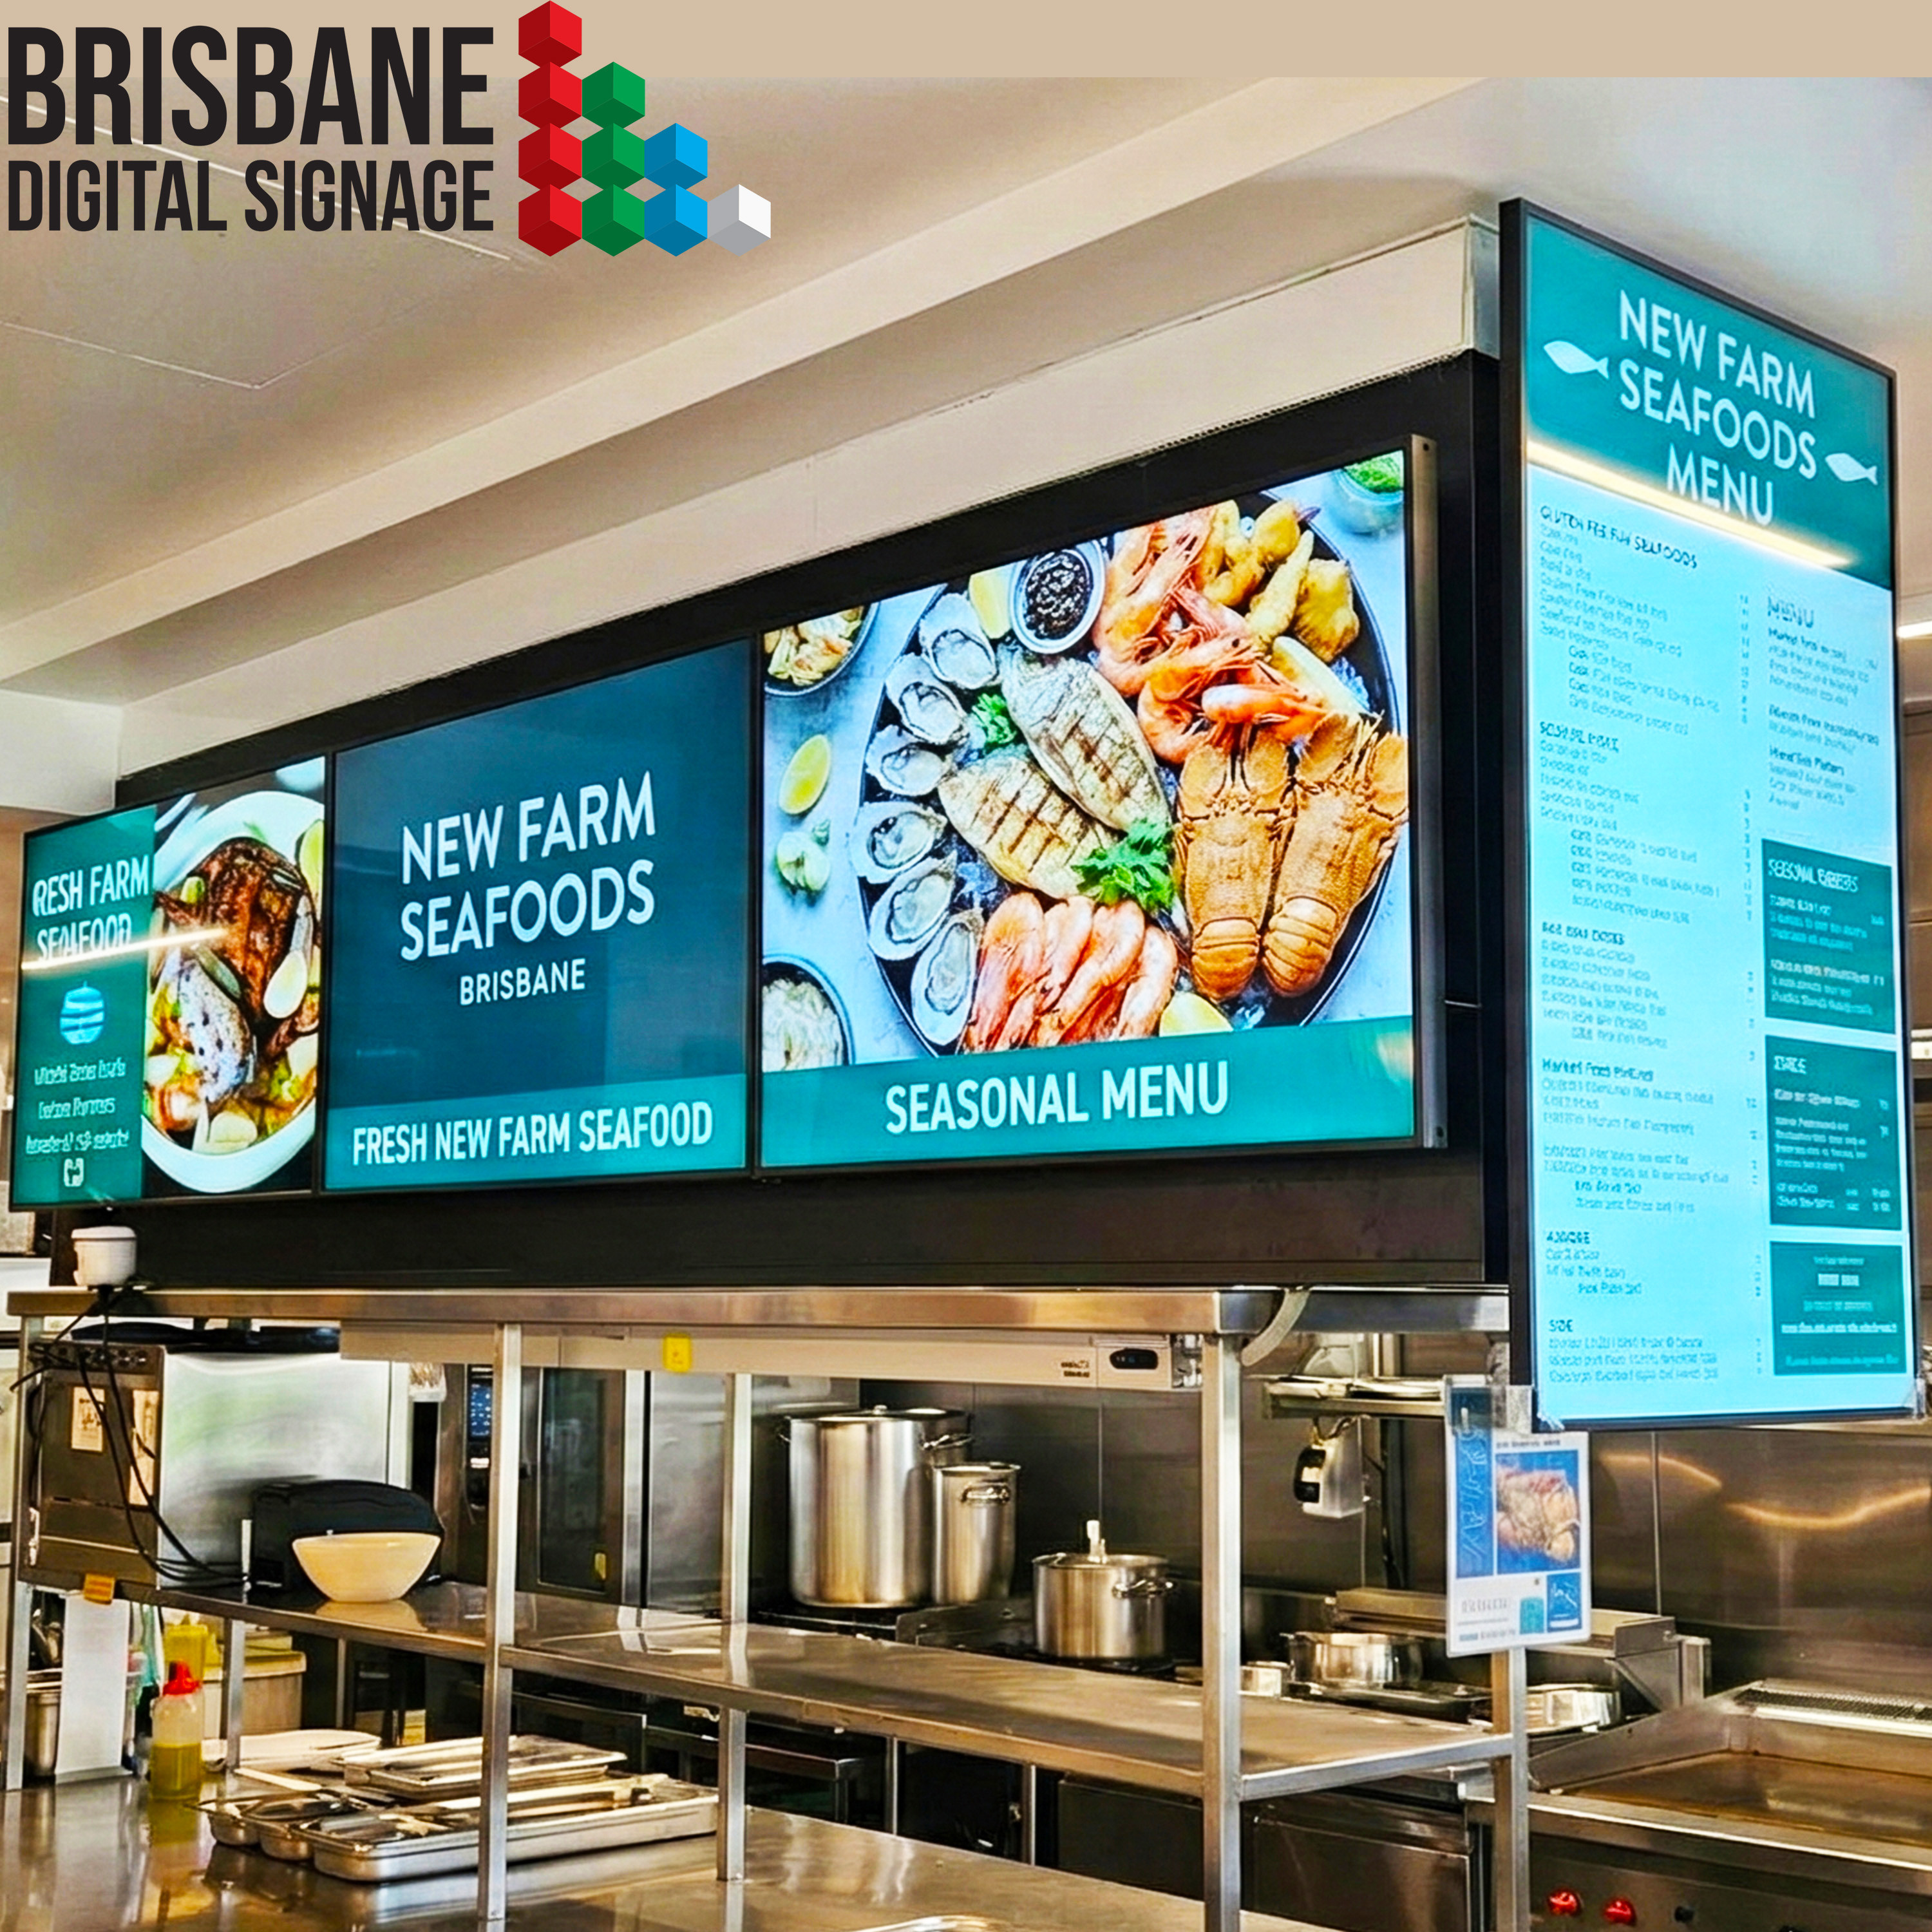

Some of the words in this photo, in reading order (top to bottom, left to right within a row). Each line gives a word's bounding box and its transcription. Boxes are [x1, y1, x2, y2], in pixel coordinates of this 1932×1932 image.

[1619, 289, 1707, 372] NEW
[1717, 332, 1815, 419] FARM
[1619, 358, 1817, 479] SEAFOODS
[1667, 442, 1773, 526] MENU
[402, 805, 504, 885] NEW
[519, 770, 656, 862] FARM
[90, 854, 149, 906] FARM
[400, 858, 655, 961] SEAFOODS
[459, 958, 586, 1005] BRISBANE
[353, 1122, 428, 1166] FRESH
[435, 1118, 492, 1160] NEW
[498, 1112, 571, 1157] FARM
[579, 1101, 714, 1152] SEAFOOD
[886, 1072, 1090, 1134] SEASONAL
[1101, 1060, 1229, 1120] MENU
